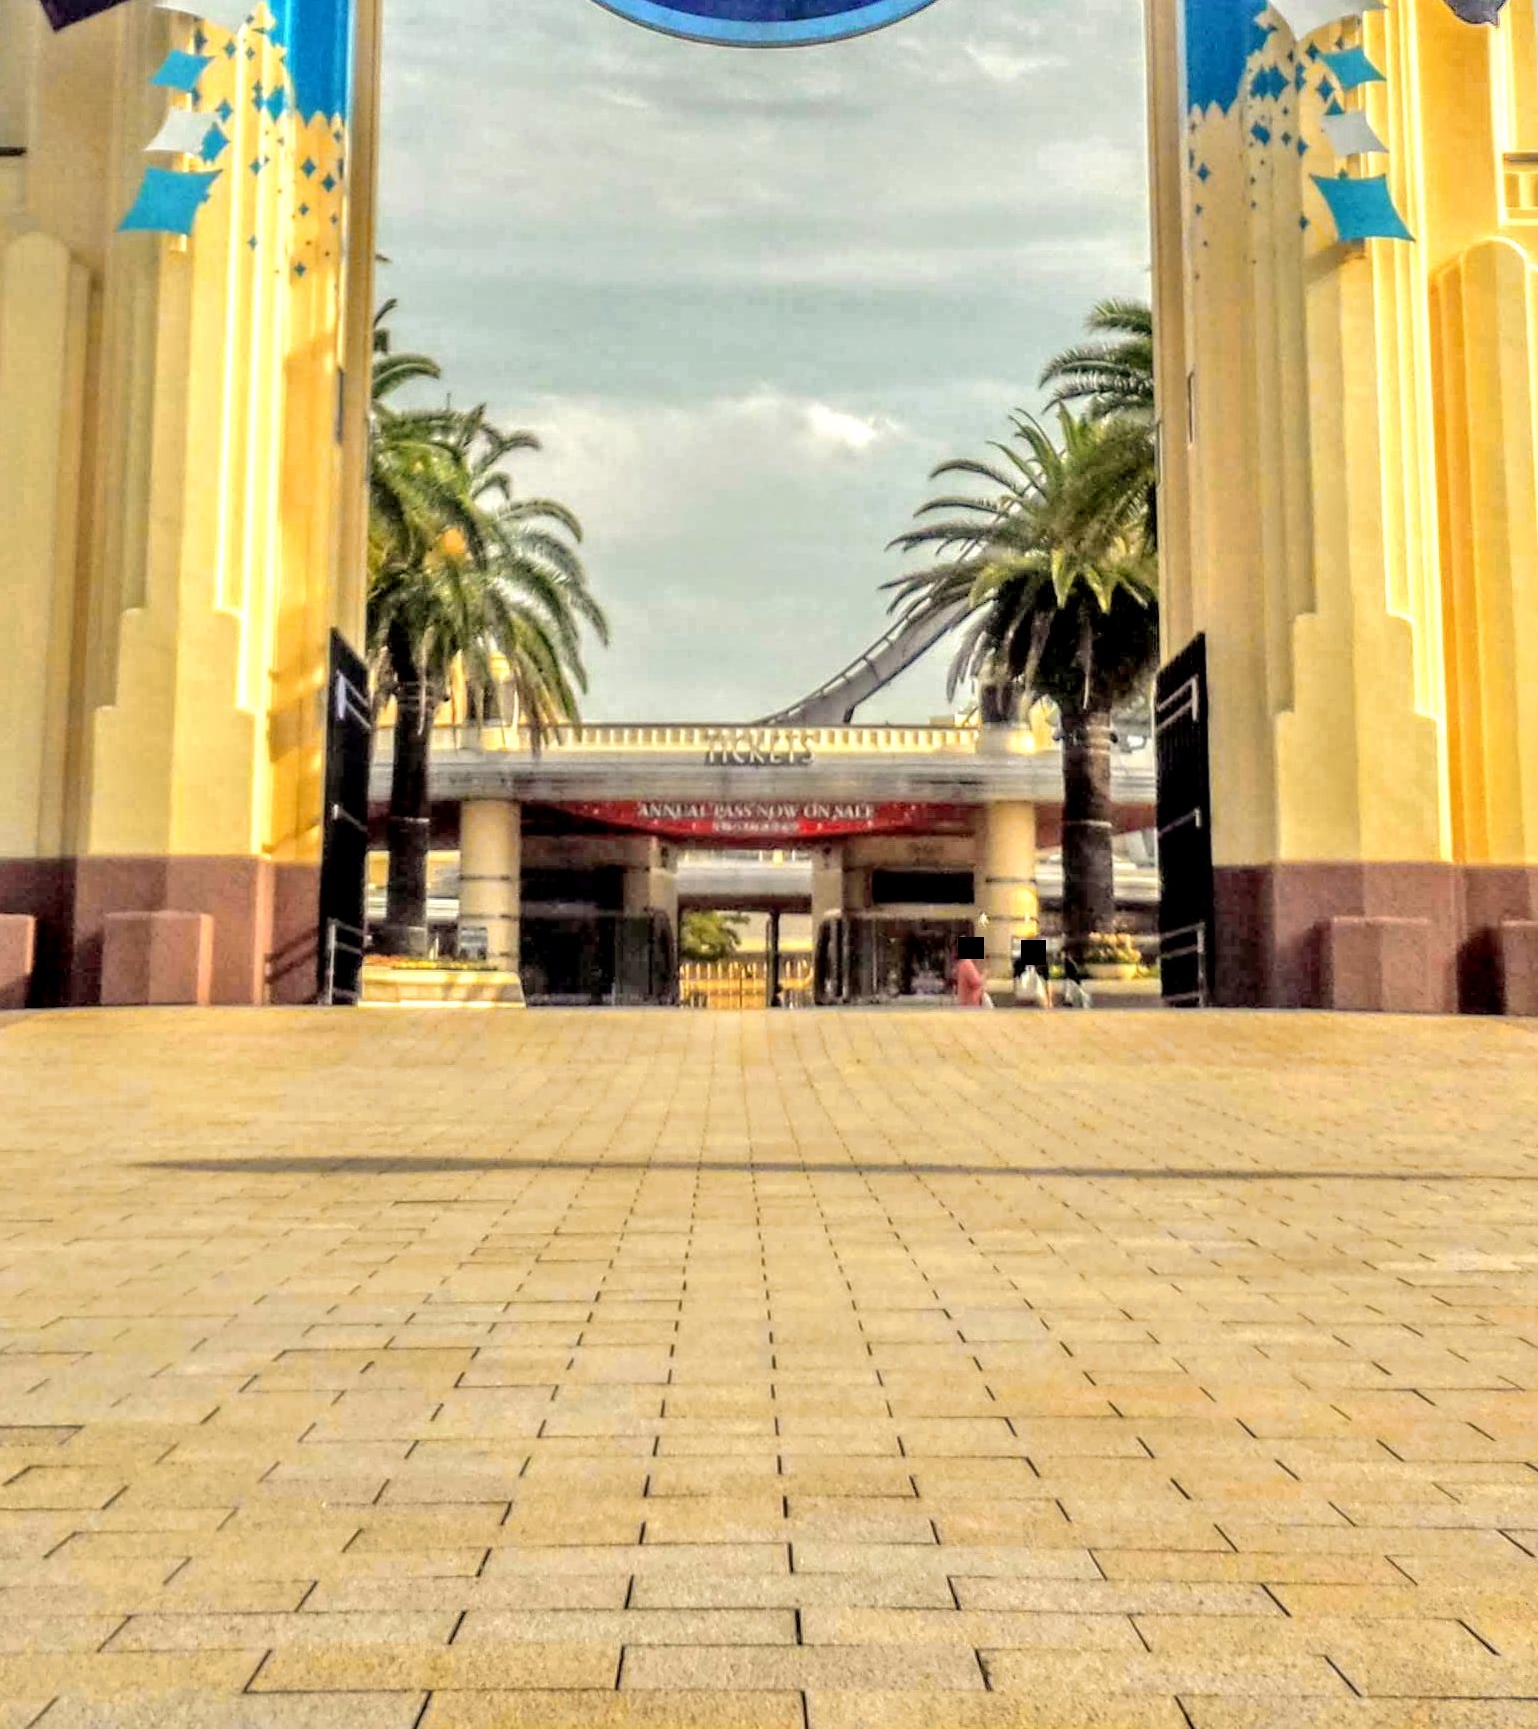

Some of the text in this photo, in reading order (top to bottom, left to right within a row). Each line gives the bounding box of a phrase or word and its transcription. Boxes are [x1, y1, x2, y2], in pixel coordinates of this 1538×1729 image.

[706, 728, 816, 765] TICKETS
[638, 802, 875, 819] ANNUAL PASS NOW ON SALE
